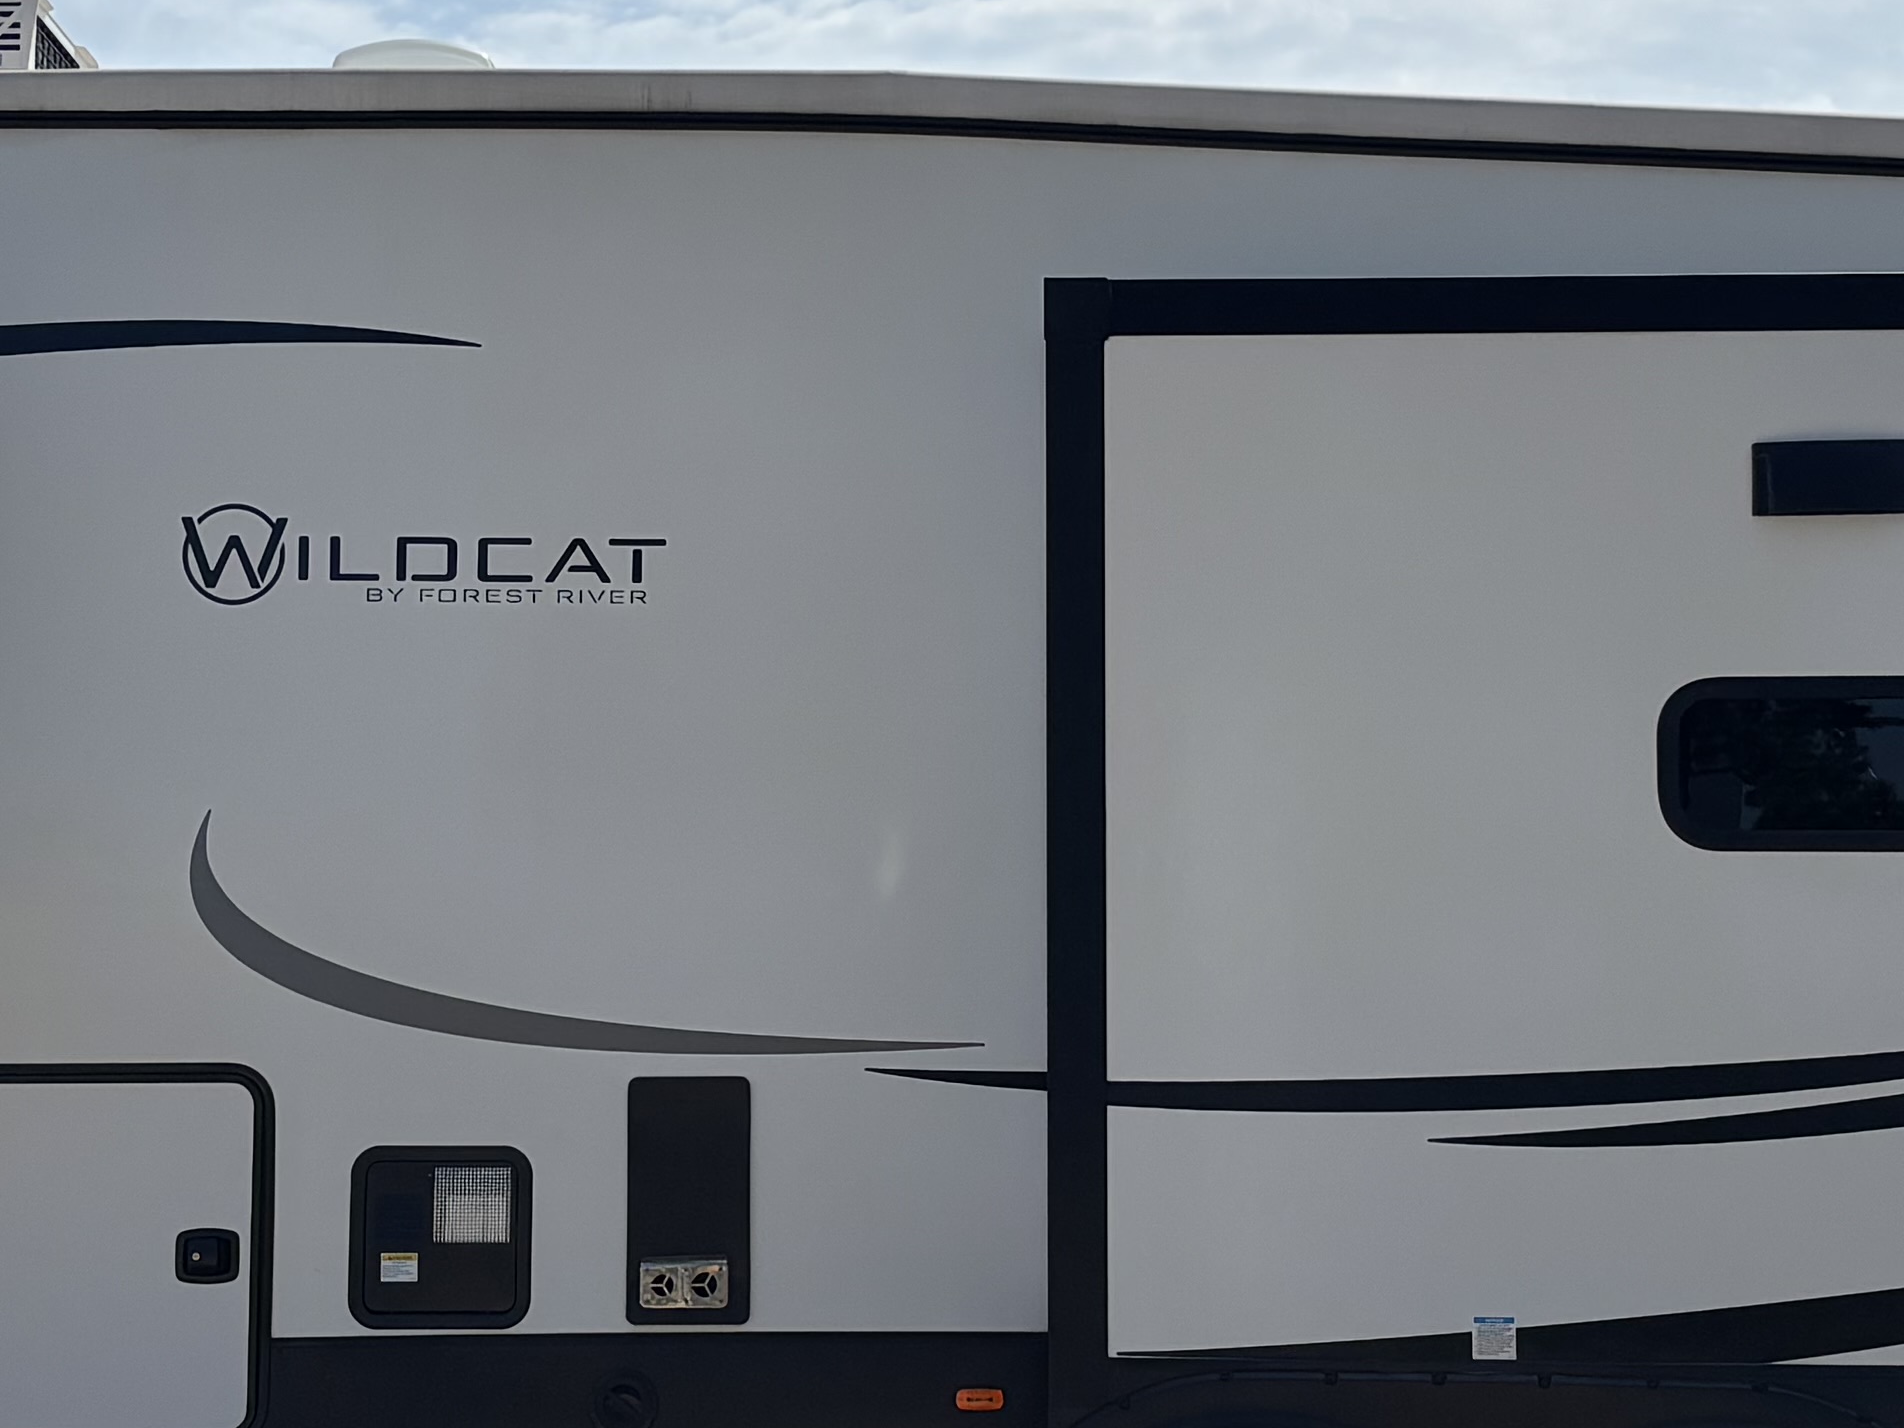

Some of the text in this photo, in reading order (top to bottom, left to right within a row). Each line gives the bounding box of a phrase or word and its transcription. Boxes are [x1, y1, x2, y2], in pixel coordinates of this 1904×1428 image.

[181, 514, 667, 590] WILDCAT
[366, 587, 648, 605] BY FOREST RIVER
